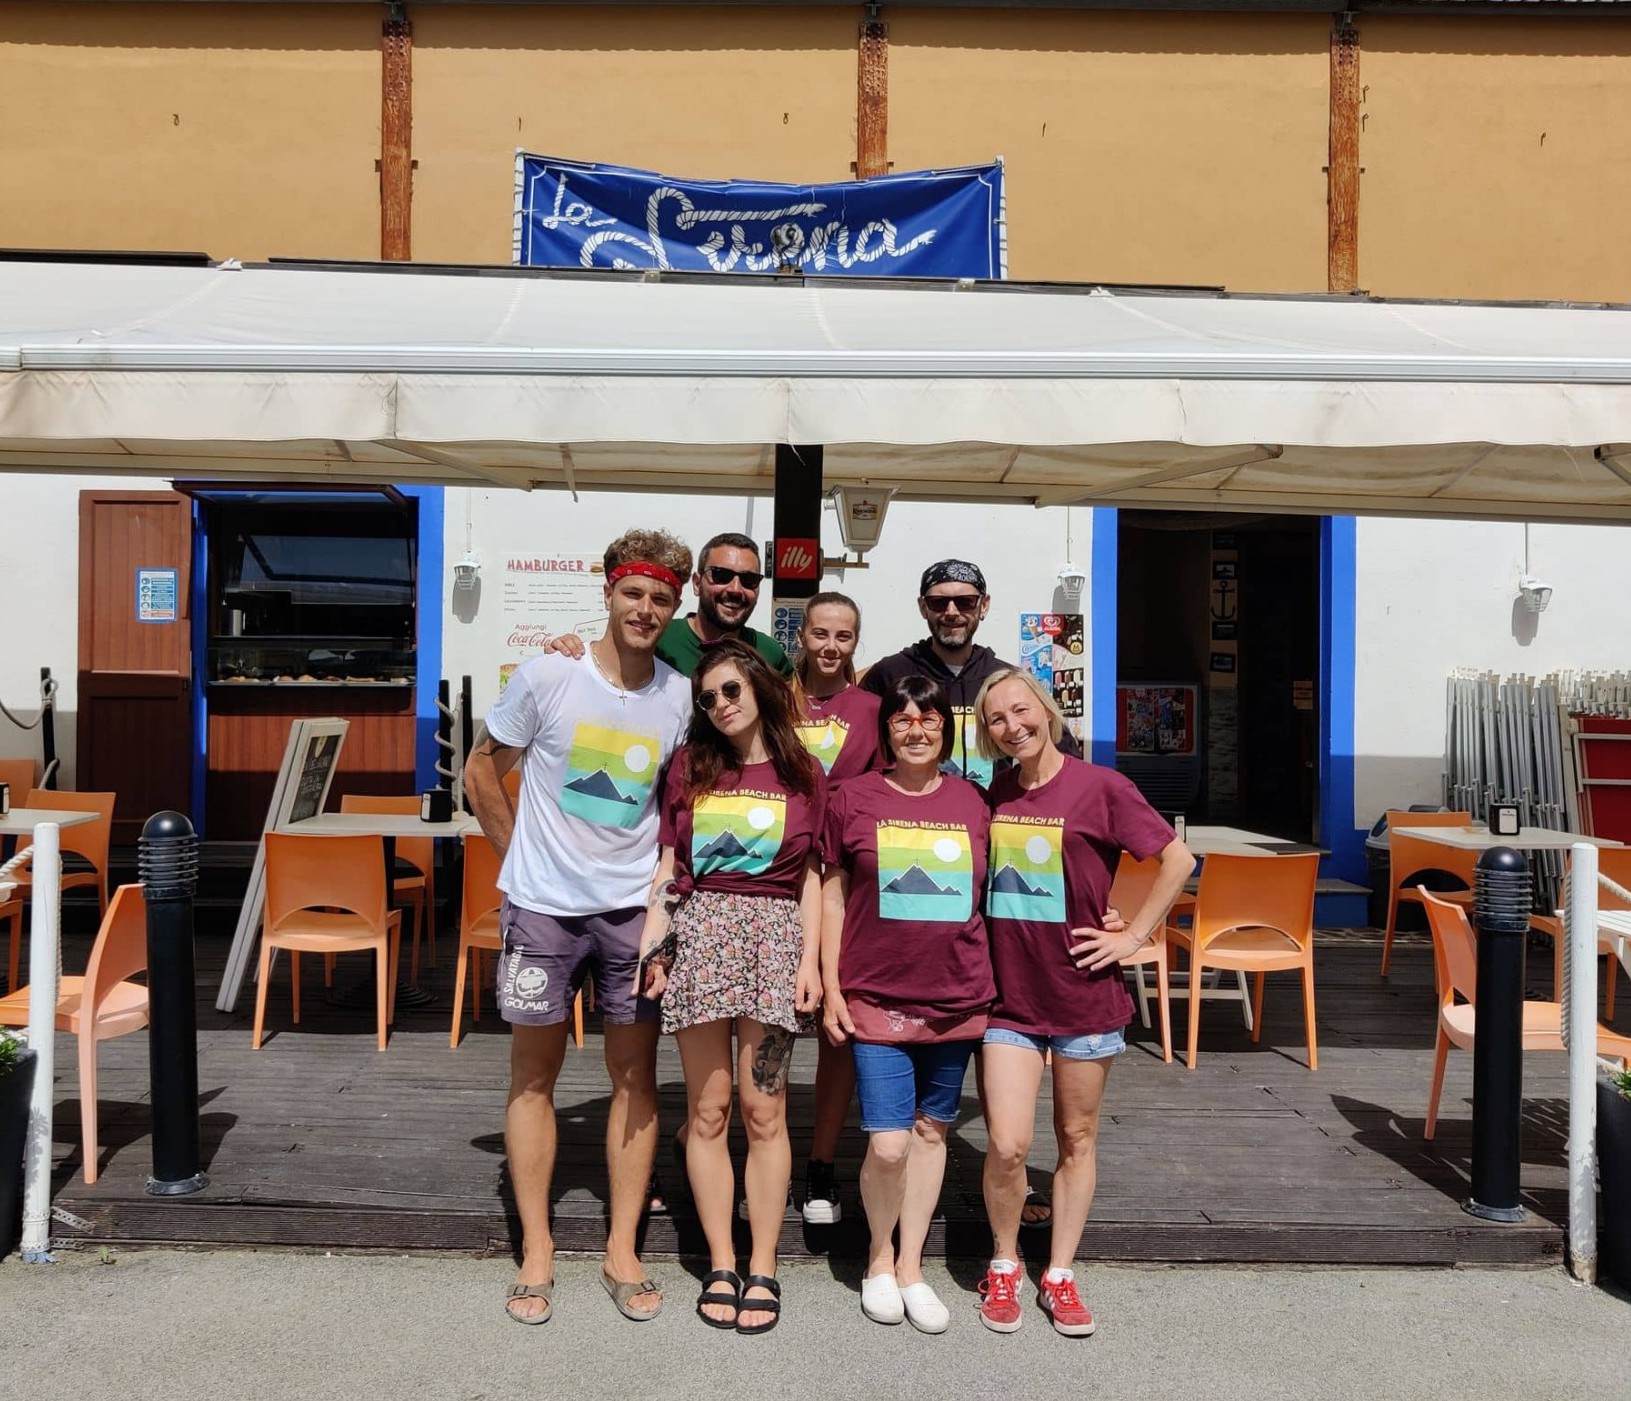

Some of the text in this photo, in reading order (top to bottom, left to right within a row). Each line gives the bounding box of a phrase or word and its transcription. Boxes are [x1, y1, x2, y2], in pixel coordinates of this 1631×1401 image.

[542, 173, 618, 229] La
[507, 559, 584, 572] HAMBURGER
[781, 546, 812, 573] illy
[514, 623, 547, 631] Aggiungi
[739, 788, 768, 799] BEACH
[769, 792, 787, 801] BAR
[876, 819, 968, 831] LA SIRENA BEACH BAR
[1019, 816, 1047, 825] BEACH
[1047, 818, 1065, 826] BAR
[504, 996, 549, 1011] GOLMAR
